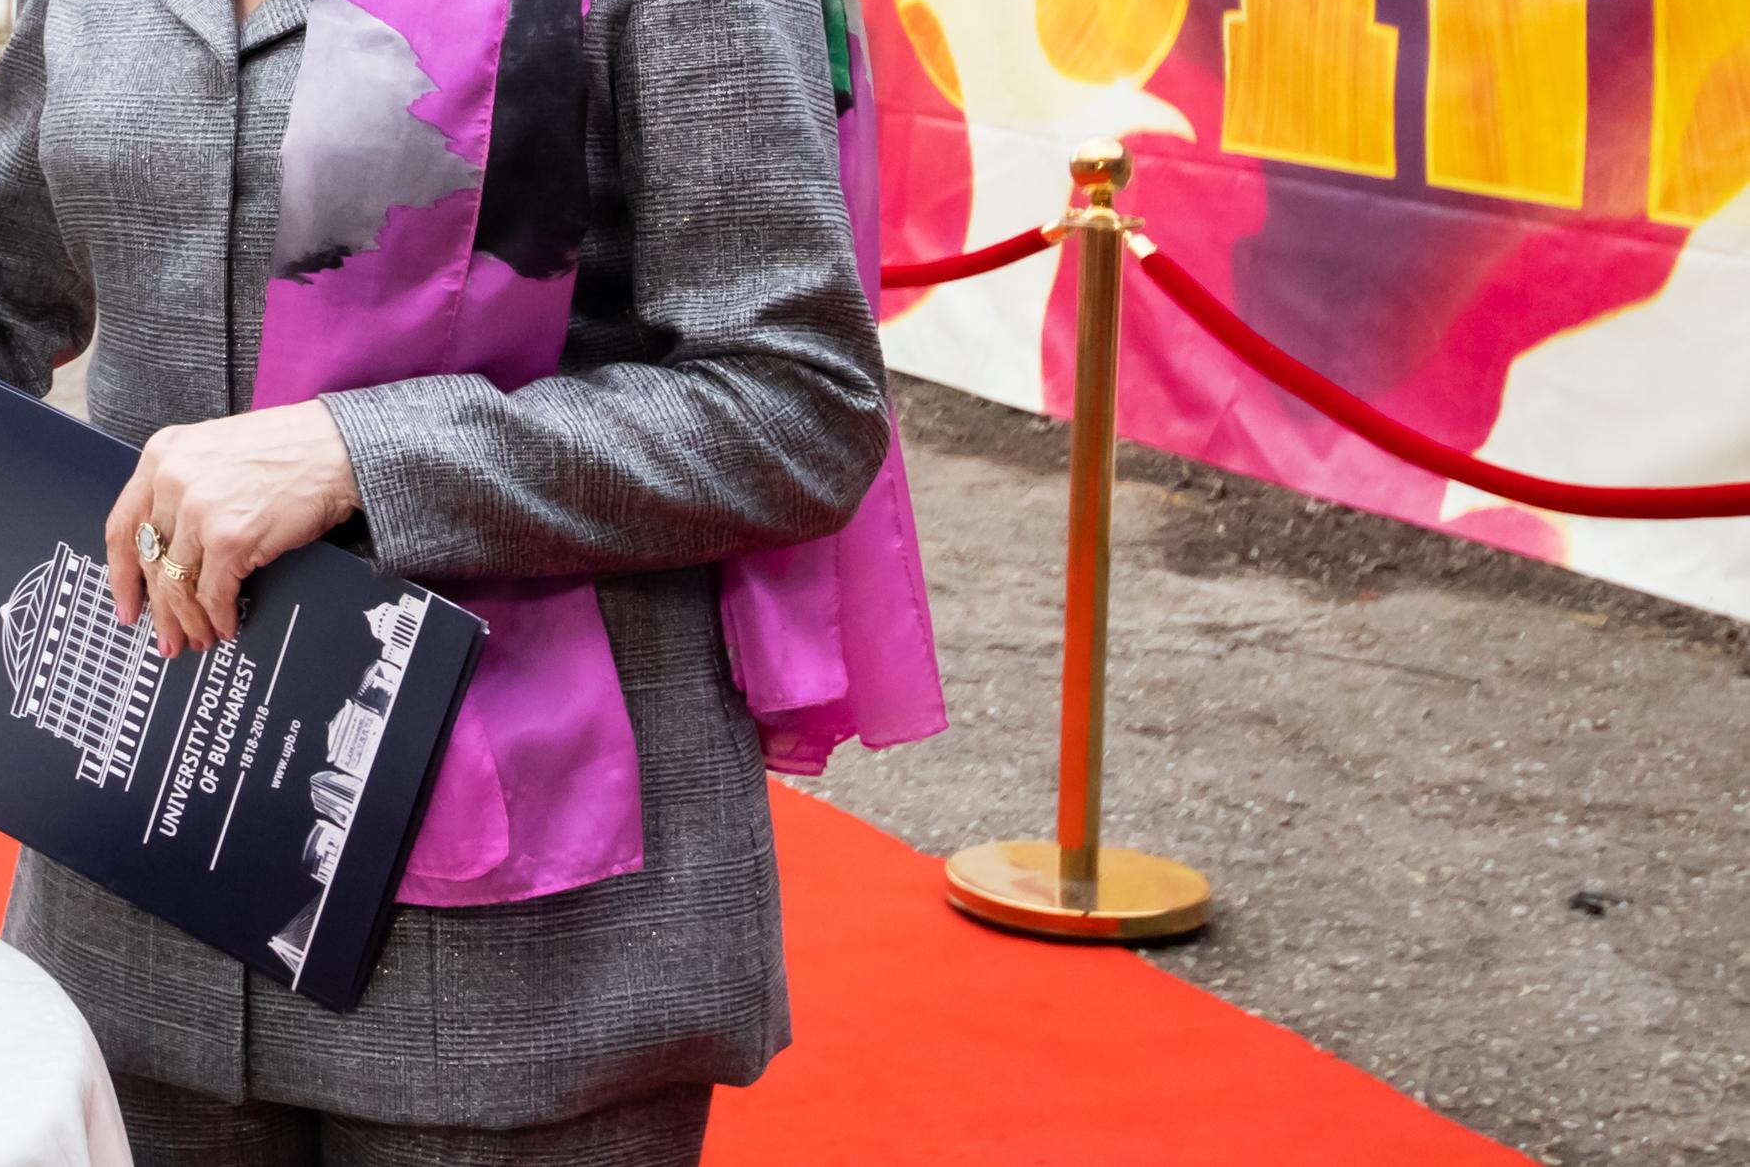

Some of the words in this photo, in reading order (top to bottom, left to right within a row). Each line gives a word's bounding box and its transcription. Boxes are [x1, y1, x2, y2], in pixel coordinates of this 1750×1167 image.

[208, 653, 257, 767] BUCHAREST
[239, 704, 269, 769] 1818-2018
[159, 720, 209, 837] UNIVERSITY
[199, 765, 220, 795] OF
[270, 719, 302, 790] www.upb.ro
